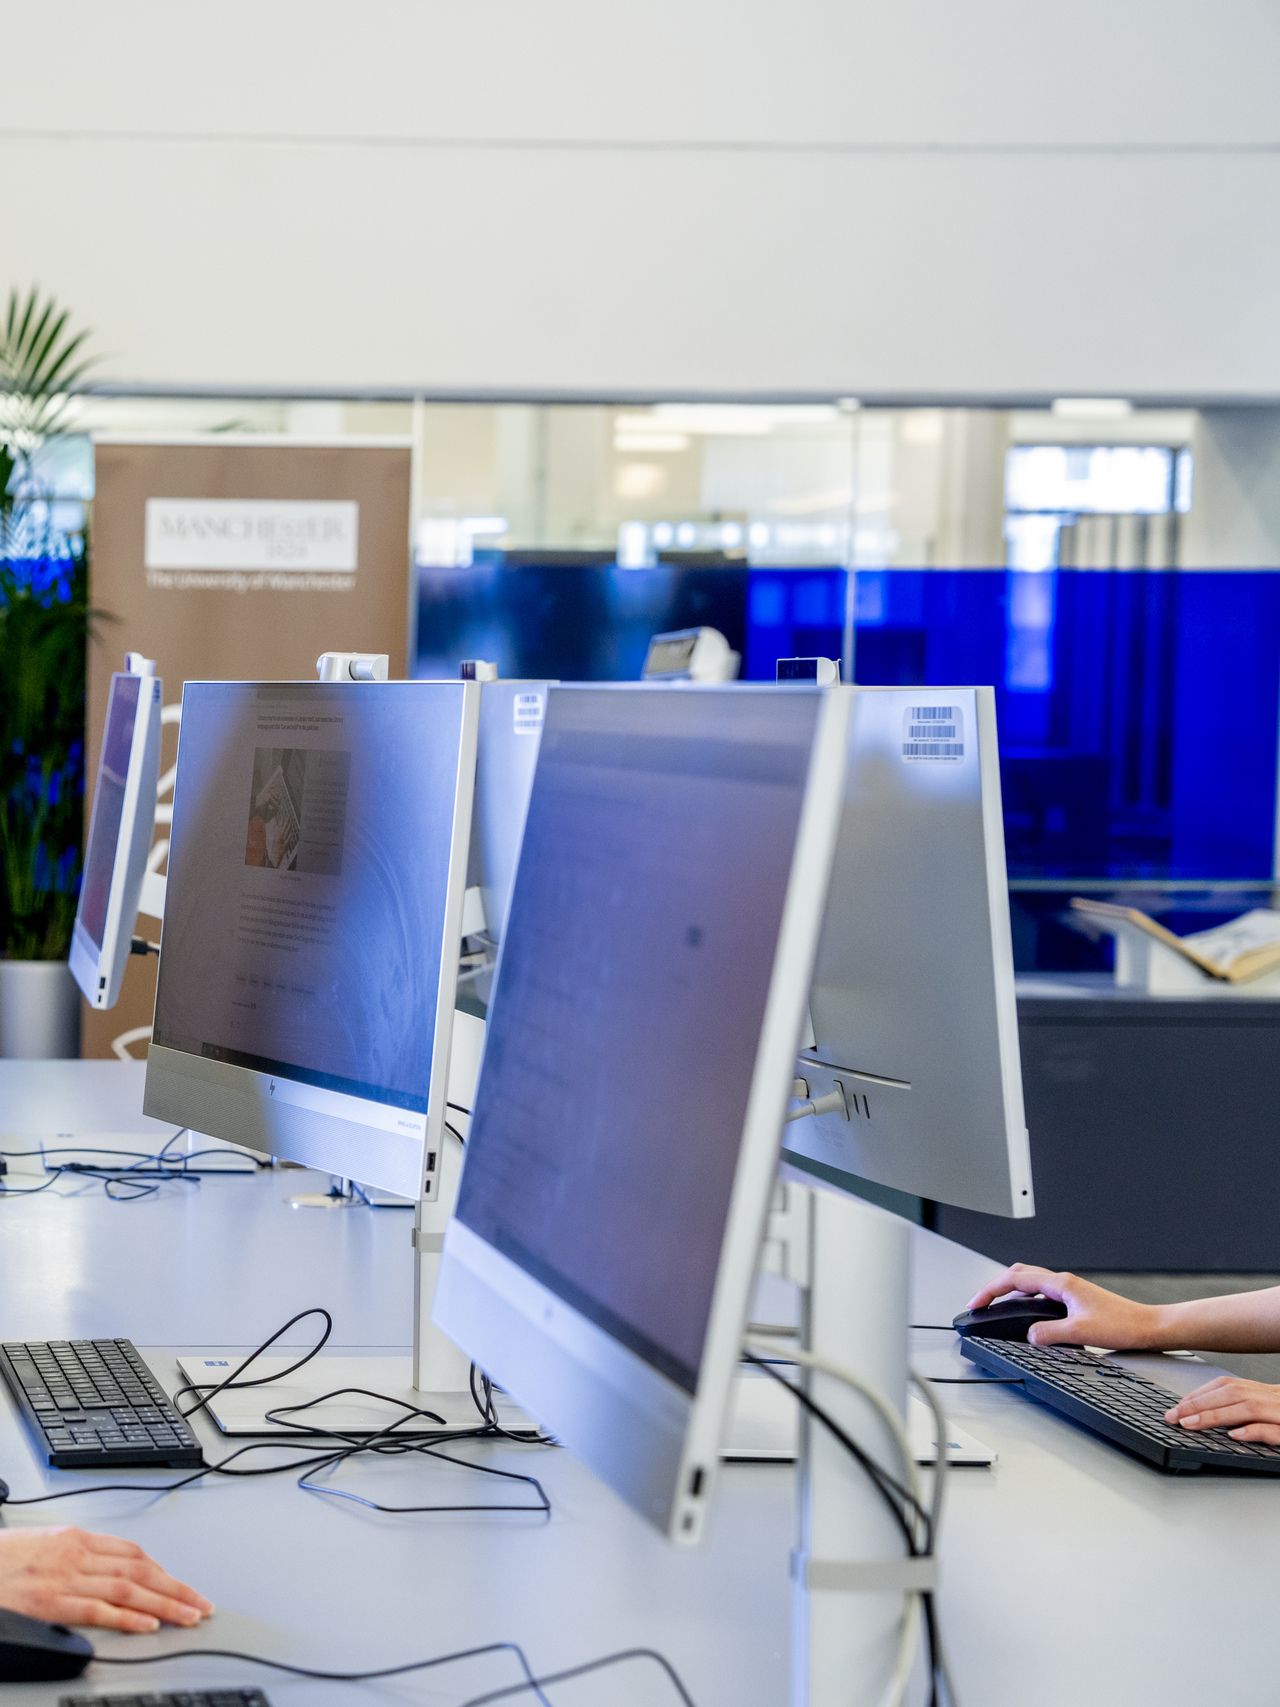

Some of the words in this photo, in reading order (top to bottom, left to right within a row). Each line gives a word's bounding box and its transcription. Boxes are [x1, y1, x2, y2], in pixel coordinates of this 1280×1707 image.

[160, 513, 344, 543] MANCHESTER
[147, 572, 172, 589] The
[176, 572, 248, 594] University
[270, 574, 355, 591] Manchester
